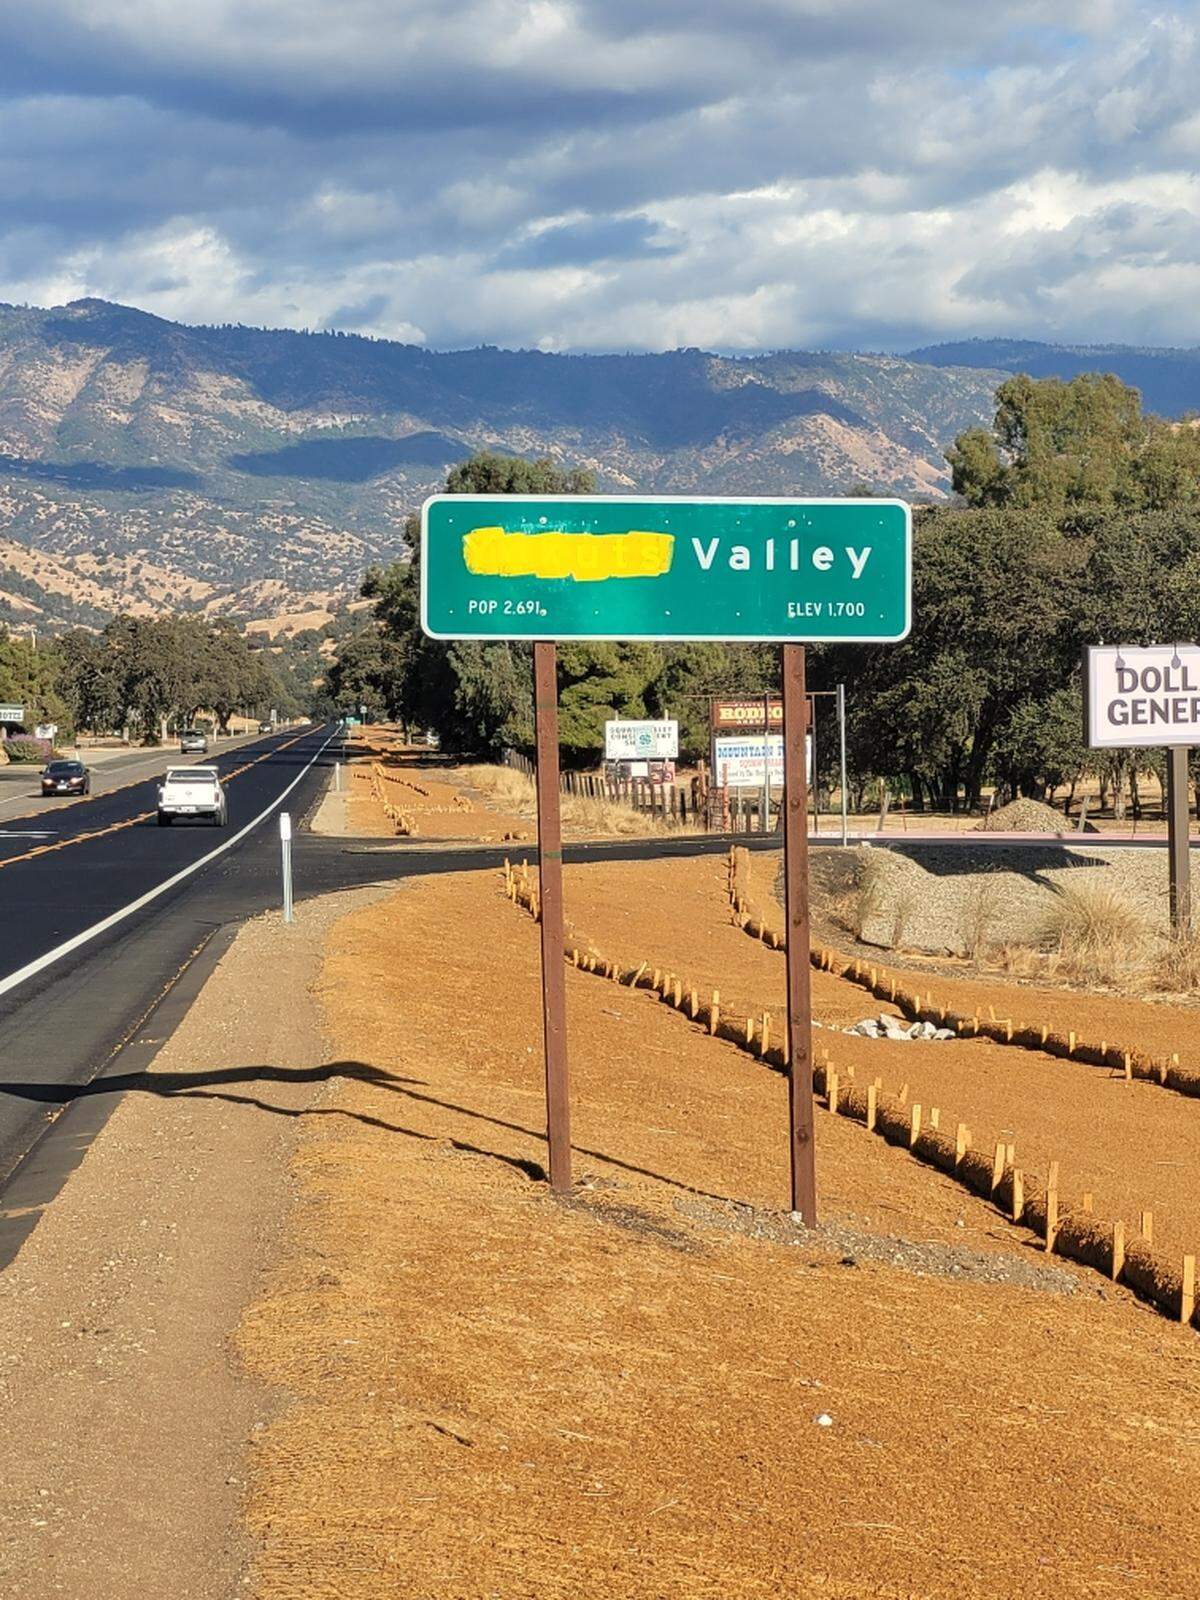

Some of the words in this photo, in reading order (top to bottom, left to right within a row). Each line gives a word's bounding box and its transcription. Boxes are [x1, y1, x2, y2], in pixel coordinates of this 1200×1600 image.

[691, 537, 872, 579] Valley
[468, 600, 498, 614] POP
[787, 602, 822, 617] ELEV
[1115, 666, 1200, 694] DOLL
